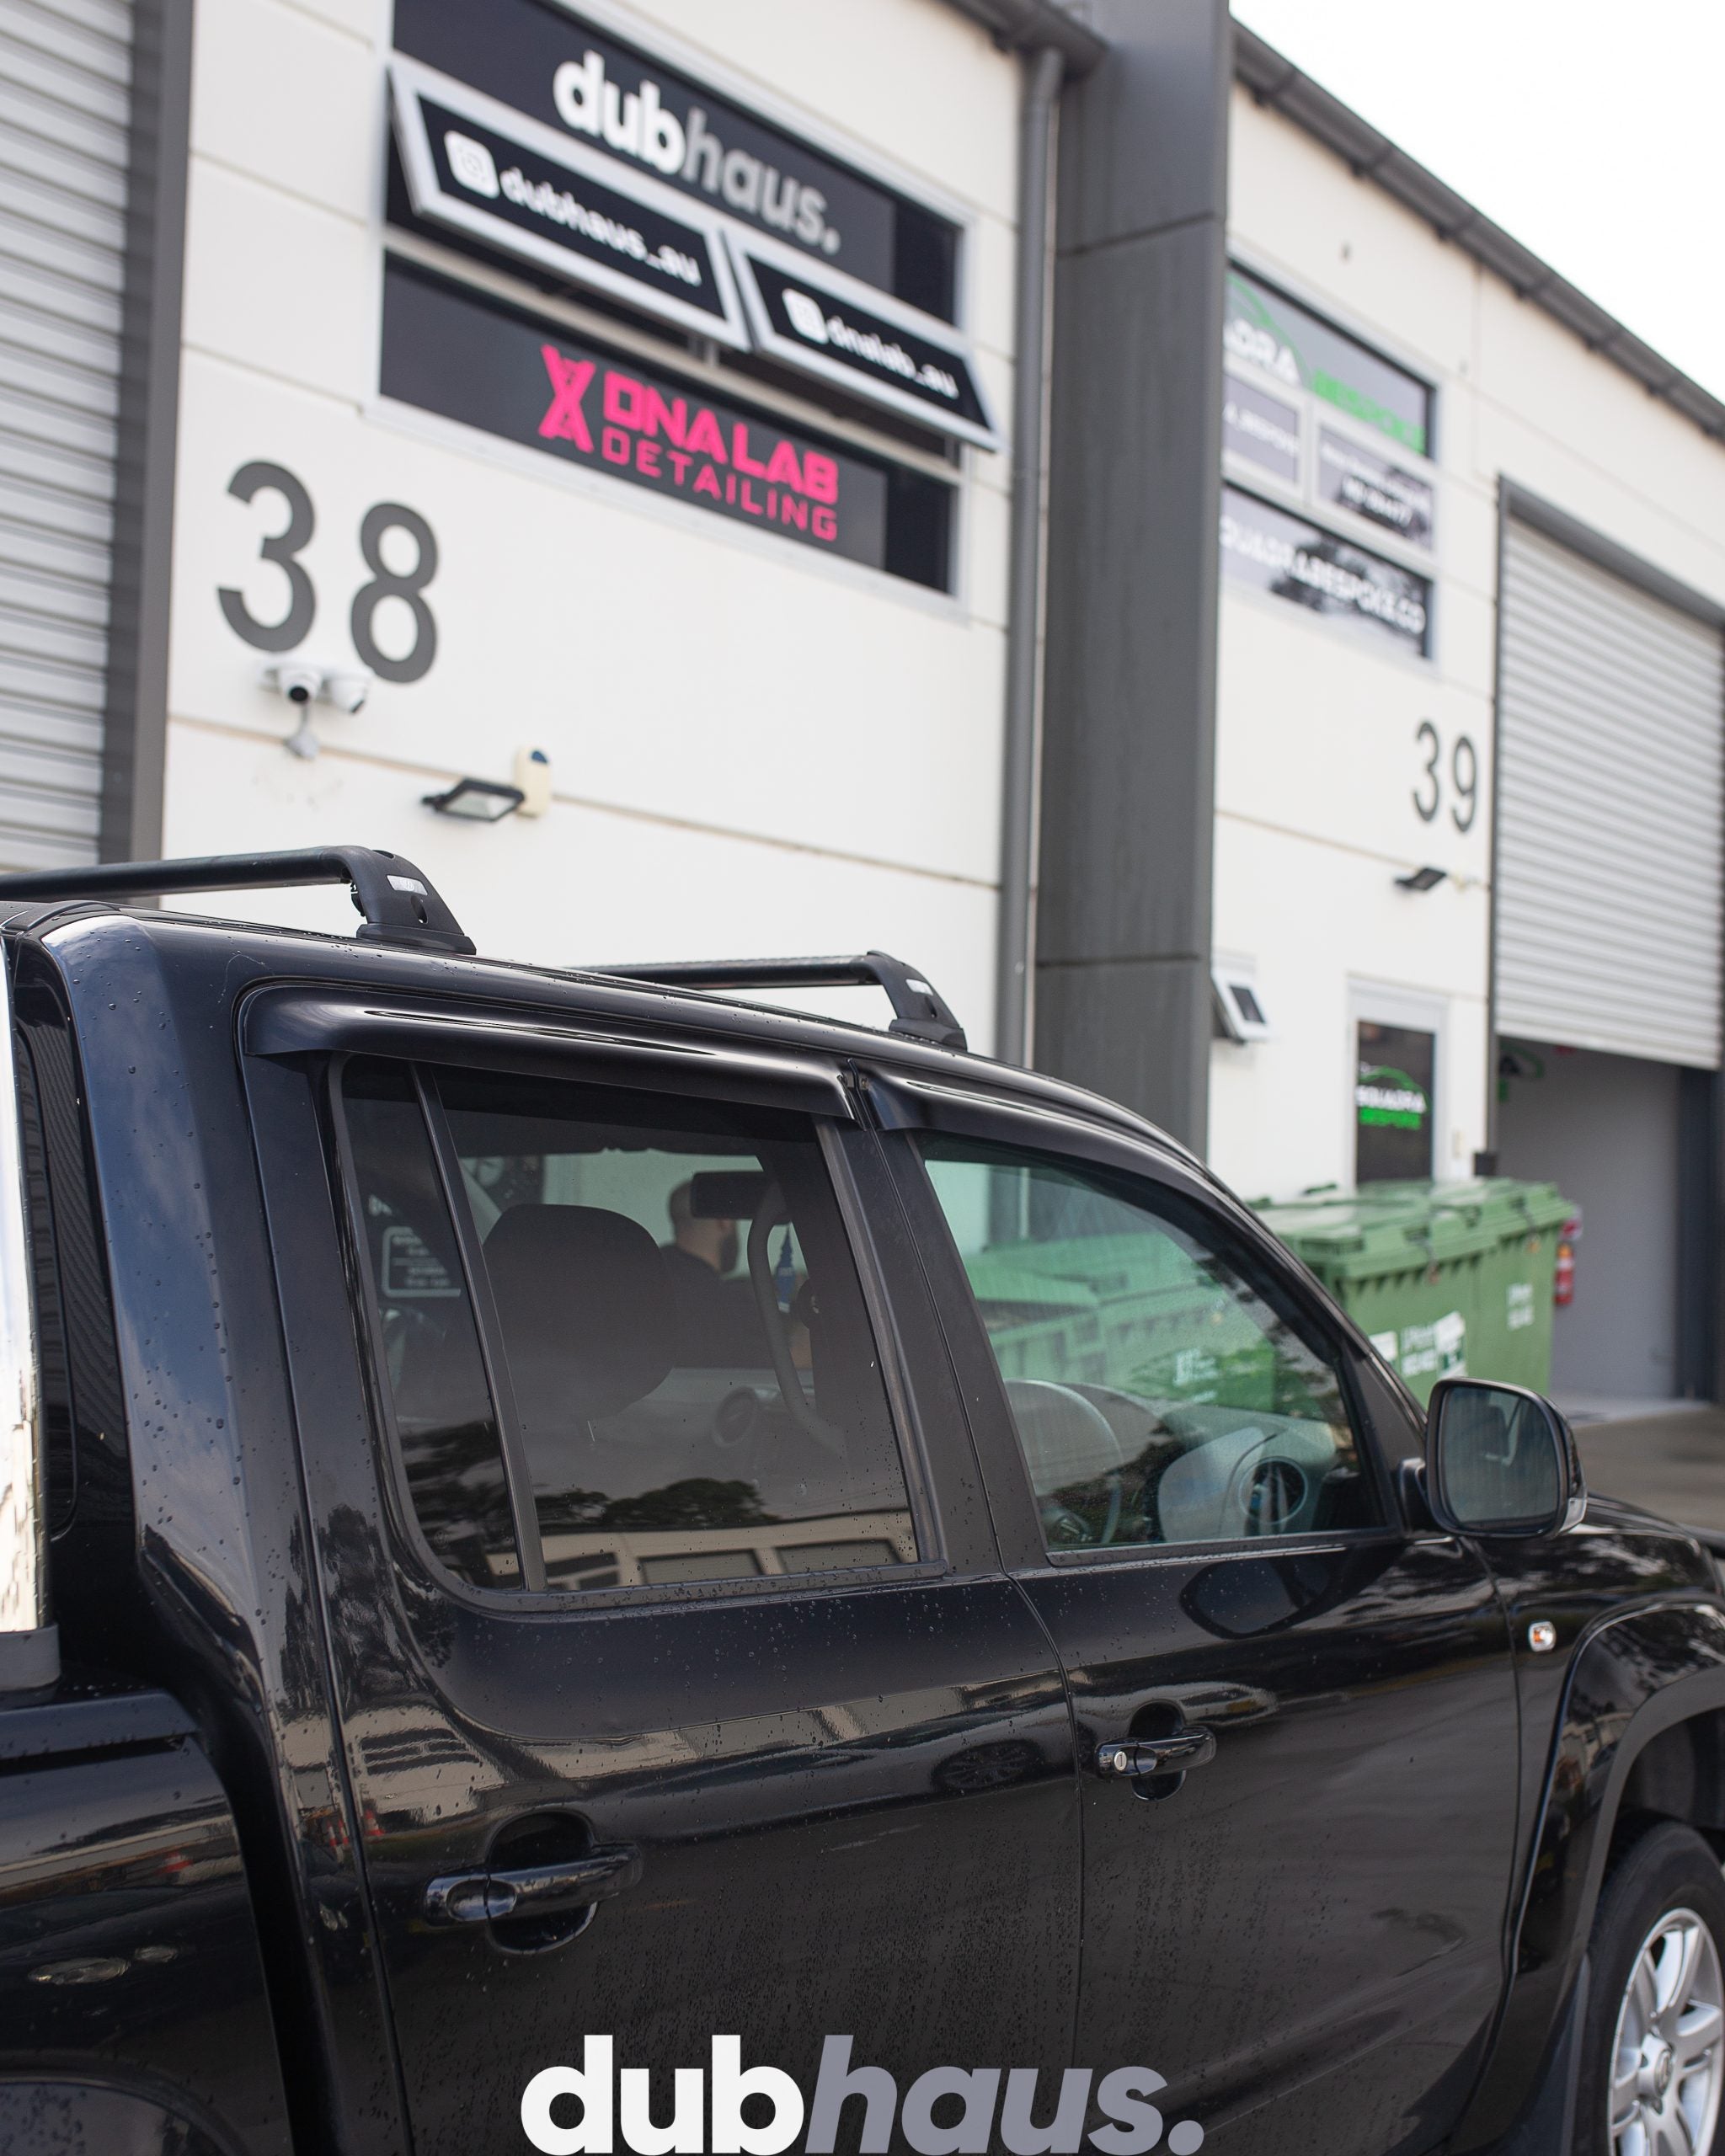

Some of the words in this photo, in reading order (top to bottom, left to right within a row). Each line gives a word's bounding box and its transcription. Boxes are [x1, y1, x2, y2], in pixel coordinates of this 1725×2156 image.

[553, 49, 841, 256] dubhaus.
[500, 166, 702, 288] dubhaus_au
[601, 425, 838, 542] DETAILING
[218, 461, 438, 684] 38
[1413, 720, 1477, 833] 39
